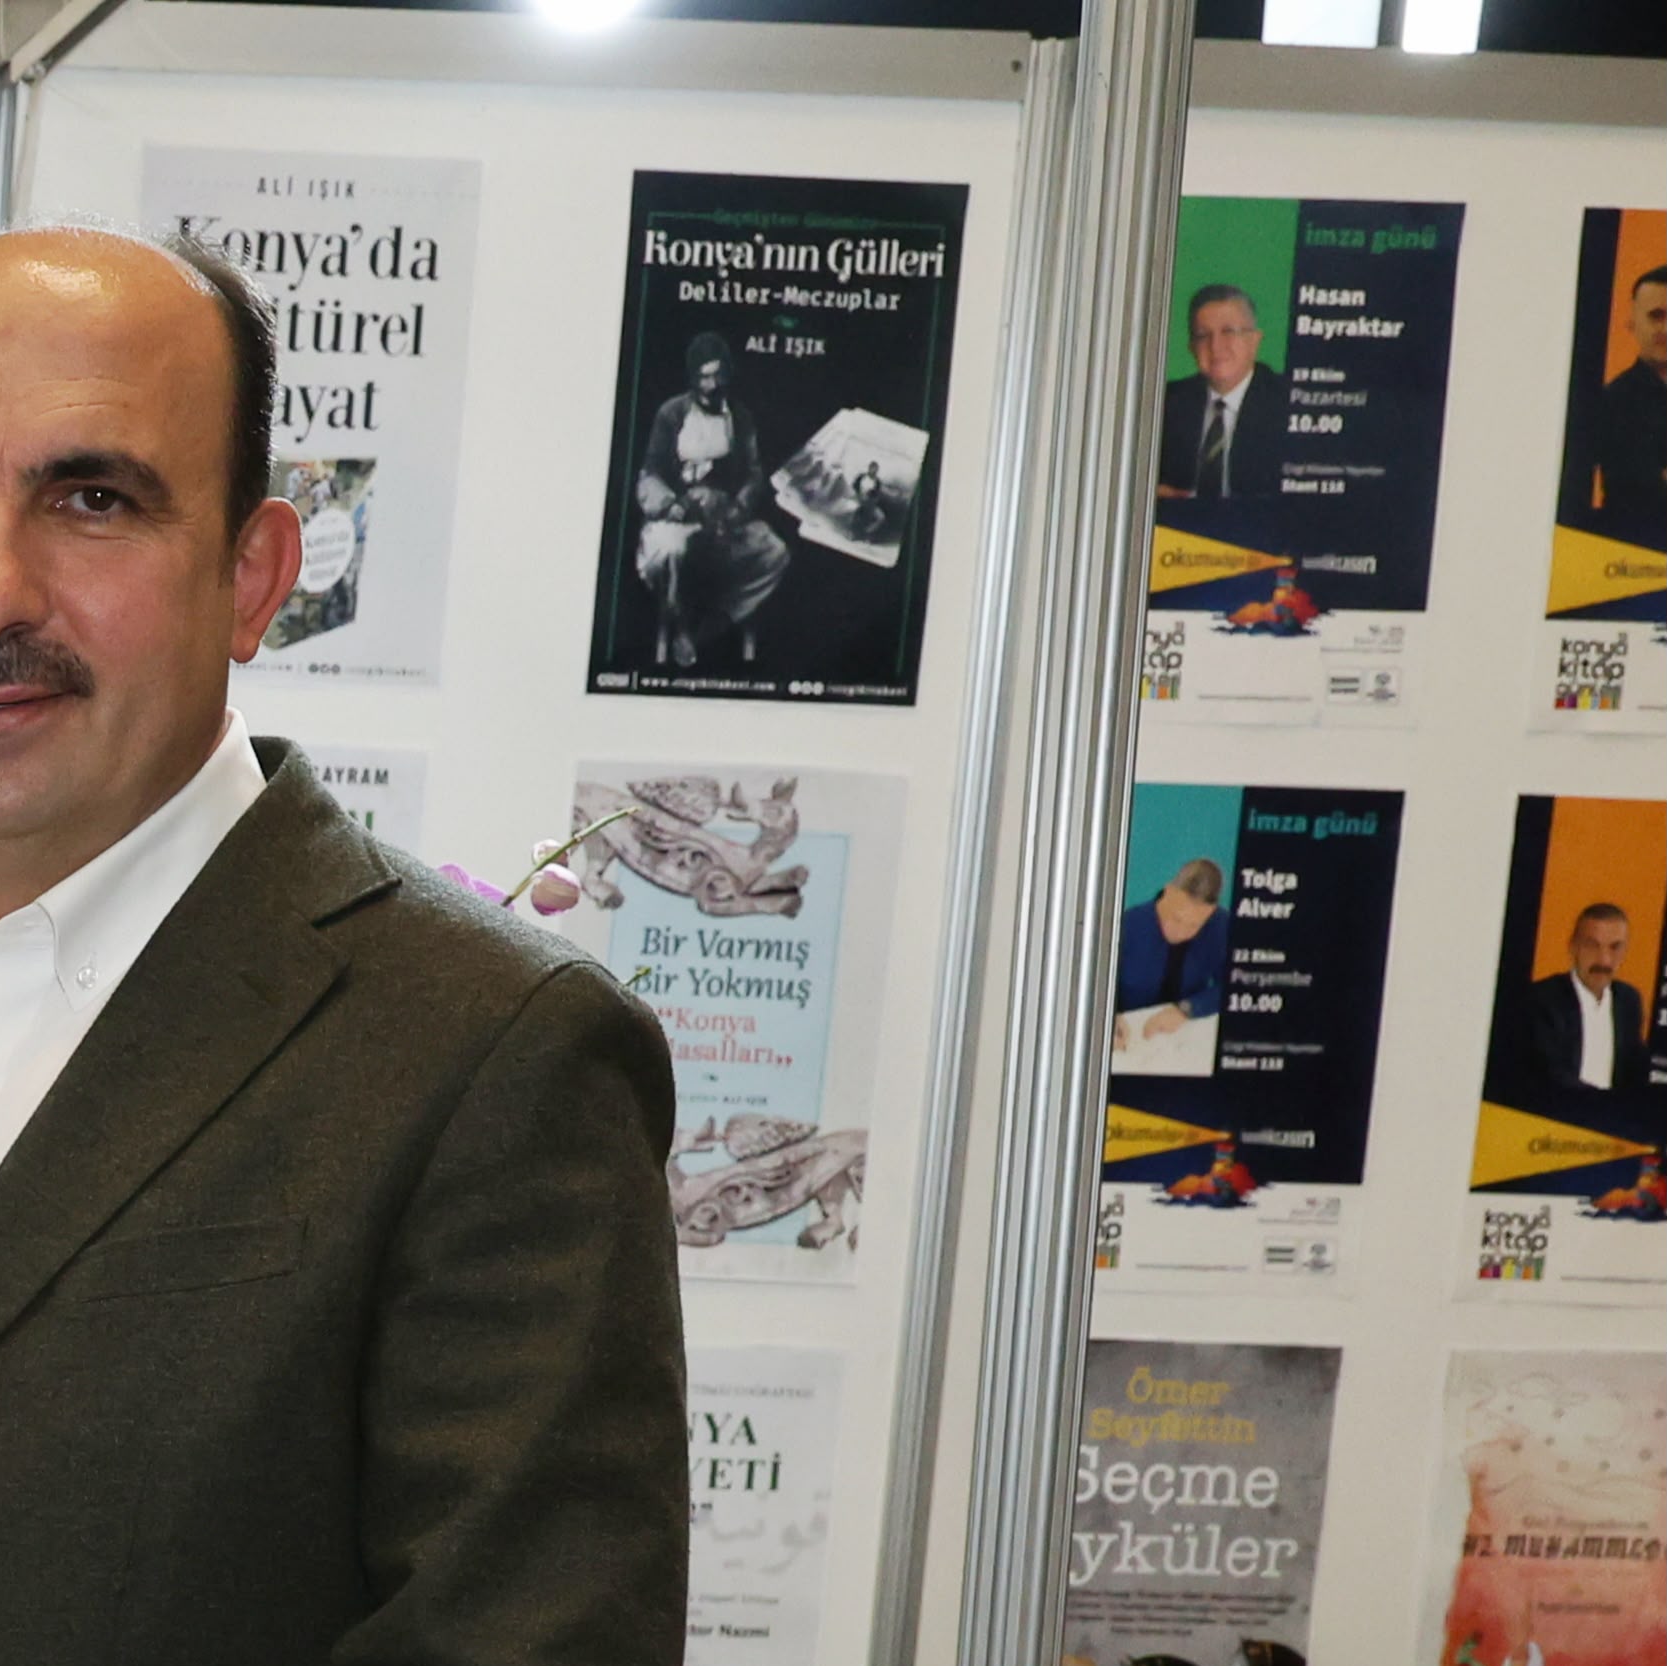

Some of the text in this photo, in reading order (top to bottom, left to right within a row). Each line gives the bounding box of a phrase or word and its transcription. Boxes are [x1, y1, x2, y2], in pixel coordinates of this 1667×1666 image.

[827, 236, 946, 283] Gülleri
[1298, 284, 1366, 307] Hasan
[274, 297, 424, 357] türel
[1296, 314, 1406, 341] Bayraktar
[273, 381, 382, 443] ayat
[315, 767, 390, 786] AYRAM
[1236, 897, 1296, 920] Alver
[640, 924, 812, 970] Bir Varmış
[687, 965, 813, 1009] Yokmuş
[1126, 1365, 1232, 1405] Ömer
[1075, 1443, 1280, 1515] Seçme
[1069, 1520, 1299, 1586] yküler
